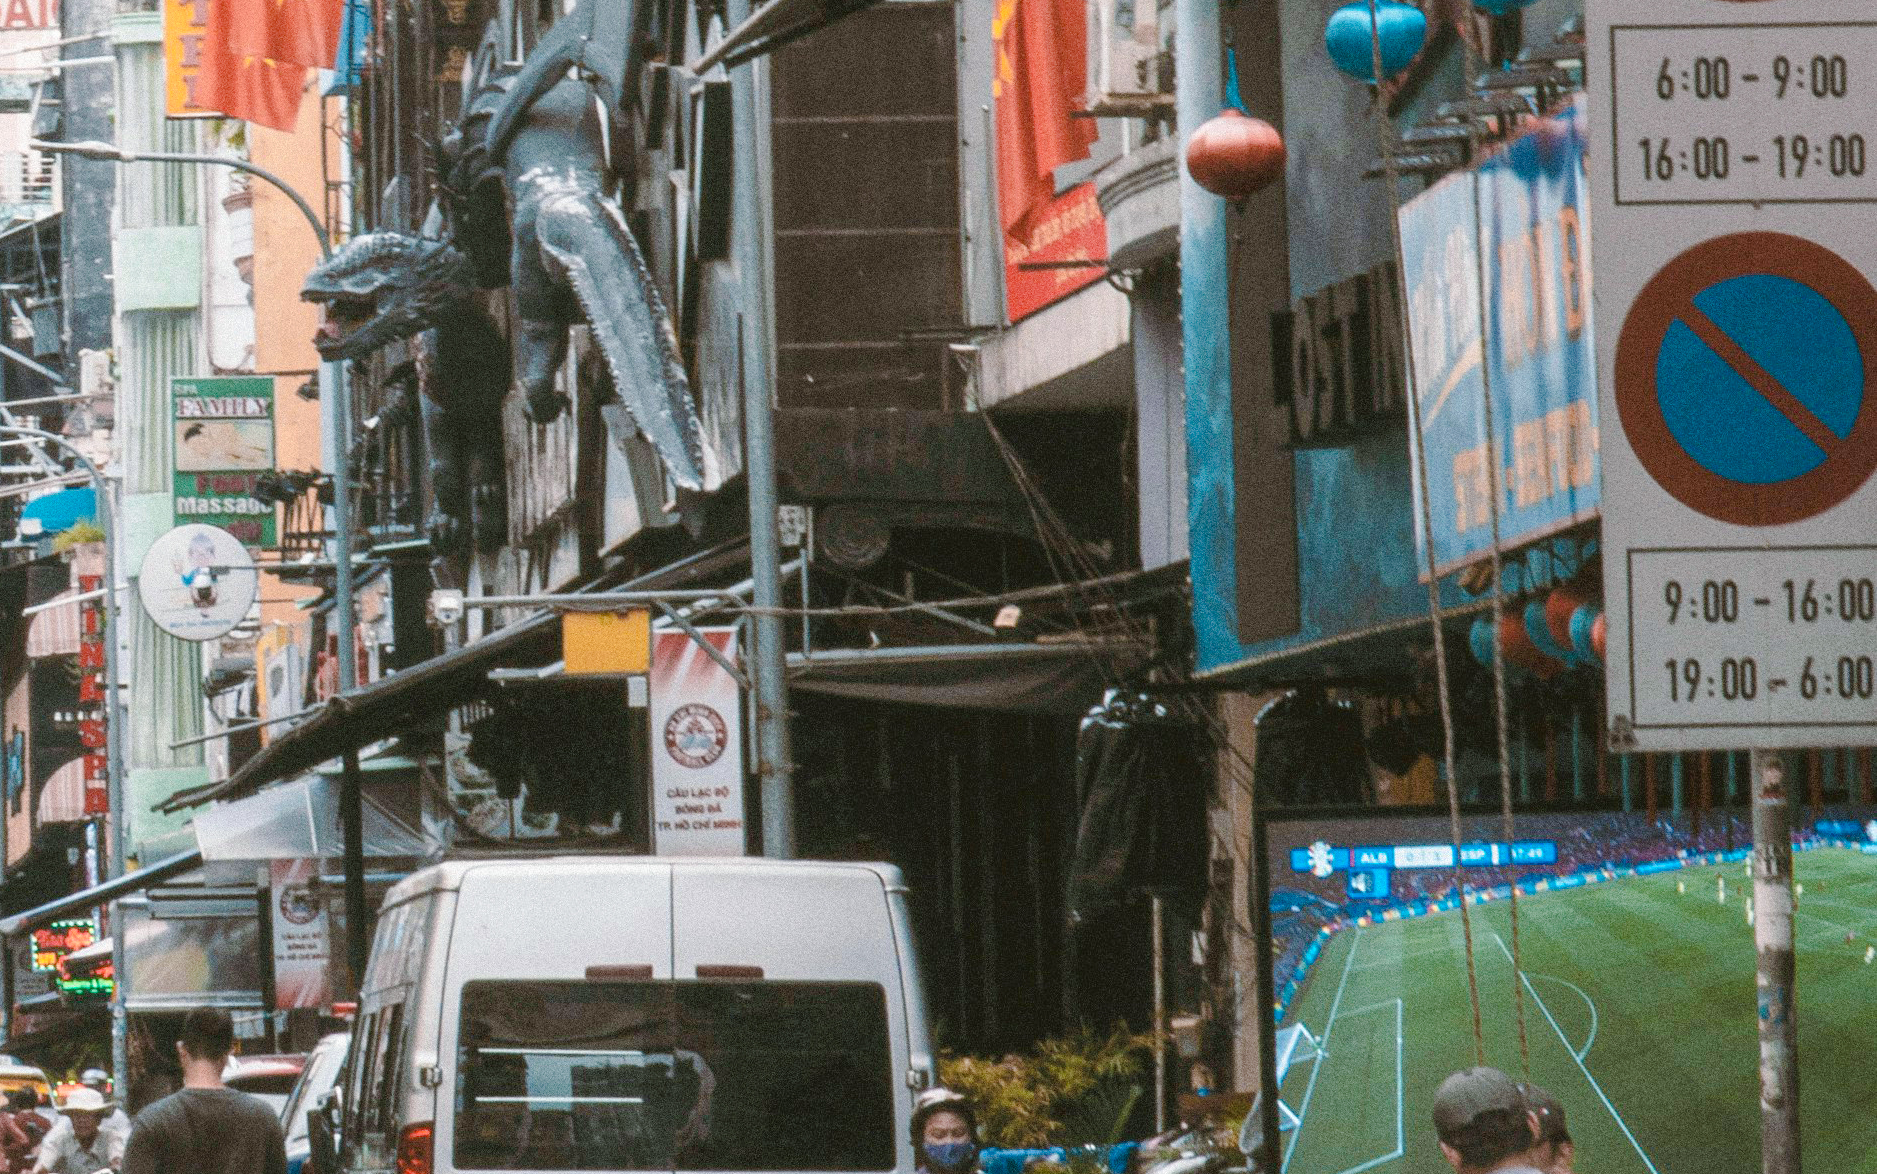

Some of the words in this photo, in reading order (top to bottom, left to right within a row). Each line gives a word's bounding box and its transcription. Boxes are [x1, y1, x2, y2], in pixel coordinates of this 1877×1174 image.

[1656, 56, 1730, 100] 6:00
[1773, 55, 1847, 99] 9:00
[1639, 137, 1729, 182] 16:00
[1773, 135, 1866, 178] 19:00
[176, 398, 269, 416] FAMILY
[1664, 580, 1738, 623] 9:00
[1783, 578, 1876, 621] 16:00
[1665, 658, 1758, 703] 19:00
[1799, 656, 1875, 700] 6:00
[1361, 853, 1388, 864] ALB
